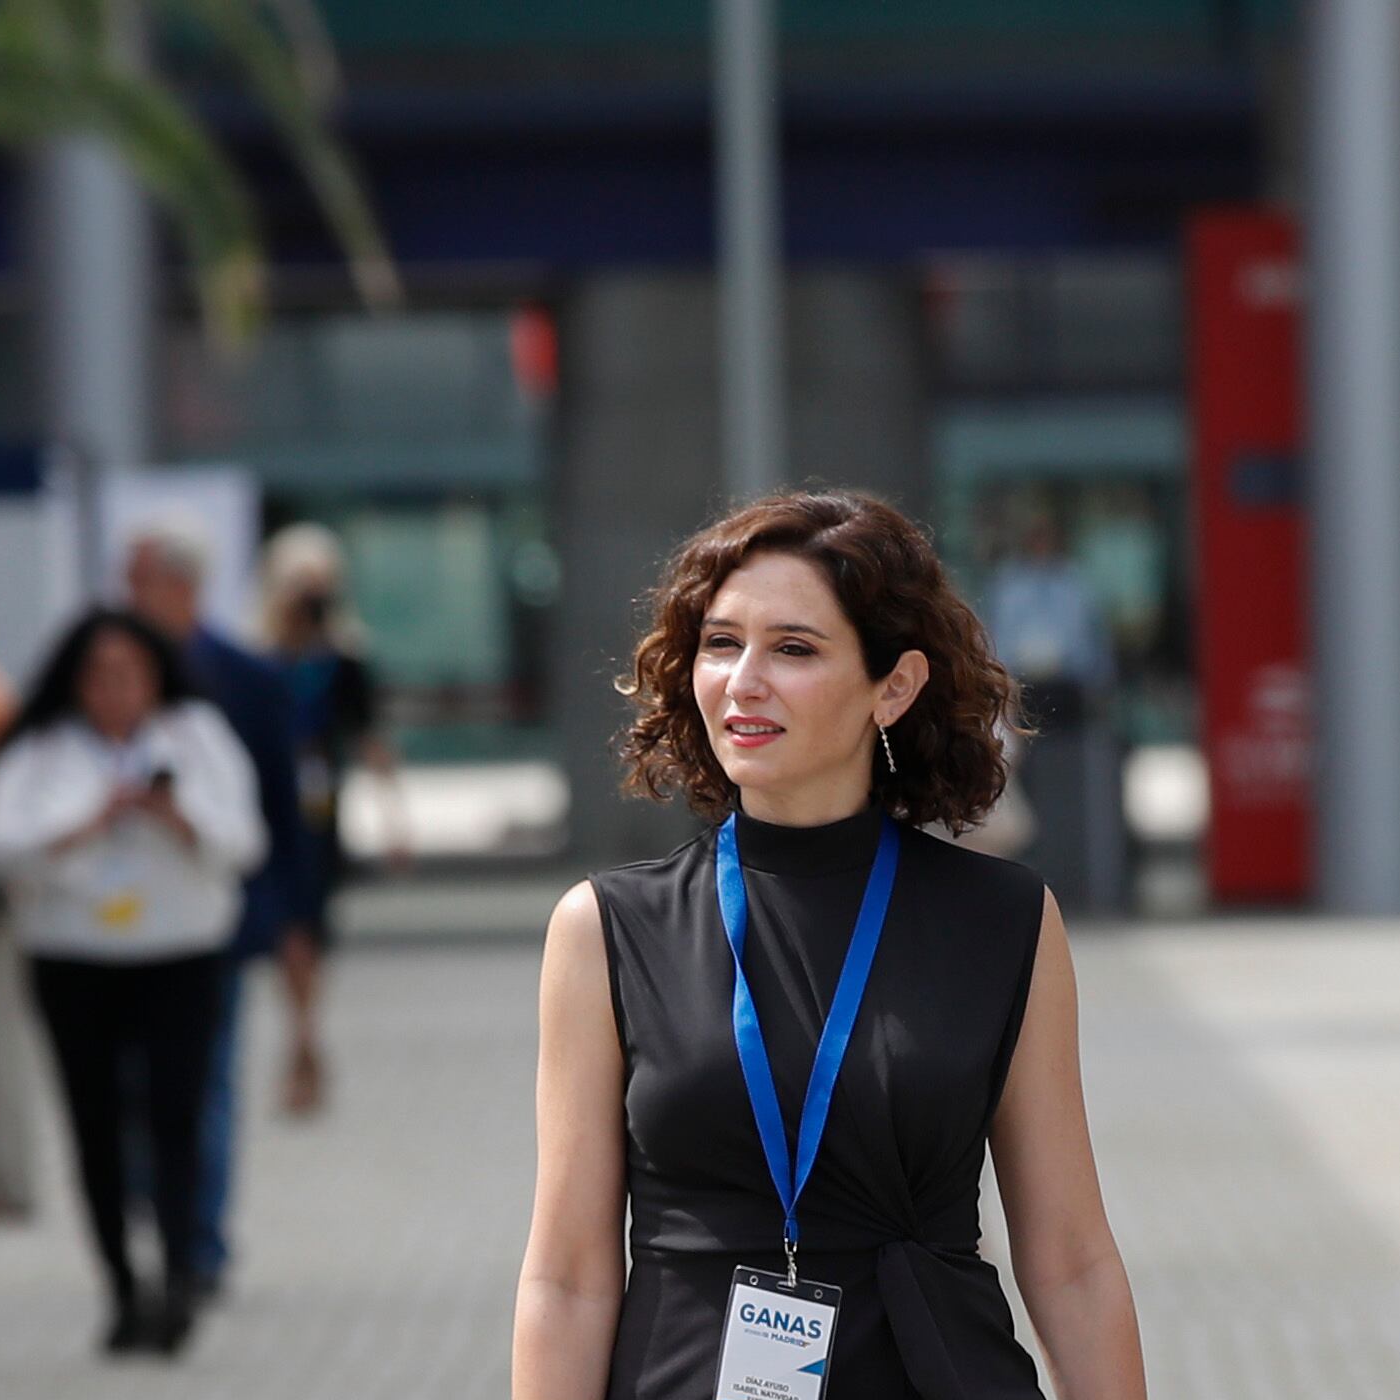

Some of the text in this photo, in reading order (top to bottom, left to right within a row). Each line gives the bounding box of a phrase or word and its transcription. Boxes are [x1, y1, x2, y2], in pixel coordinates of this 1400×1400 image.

[740, 1303, 823, 1340] GANAS
[733, 1383, 759, 1396] ISABEL
[763, 1381, 789, 1393] AYUSO
